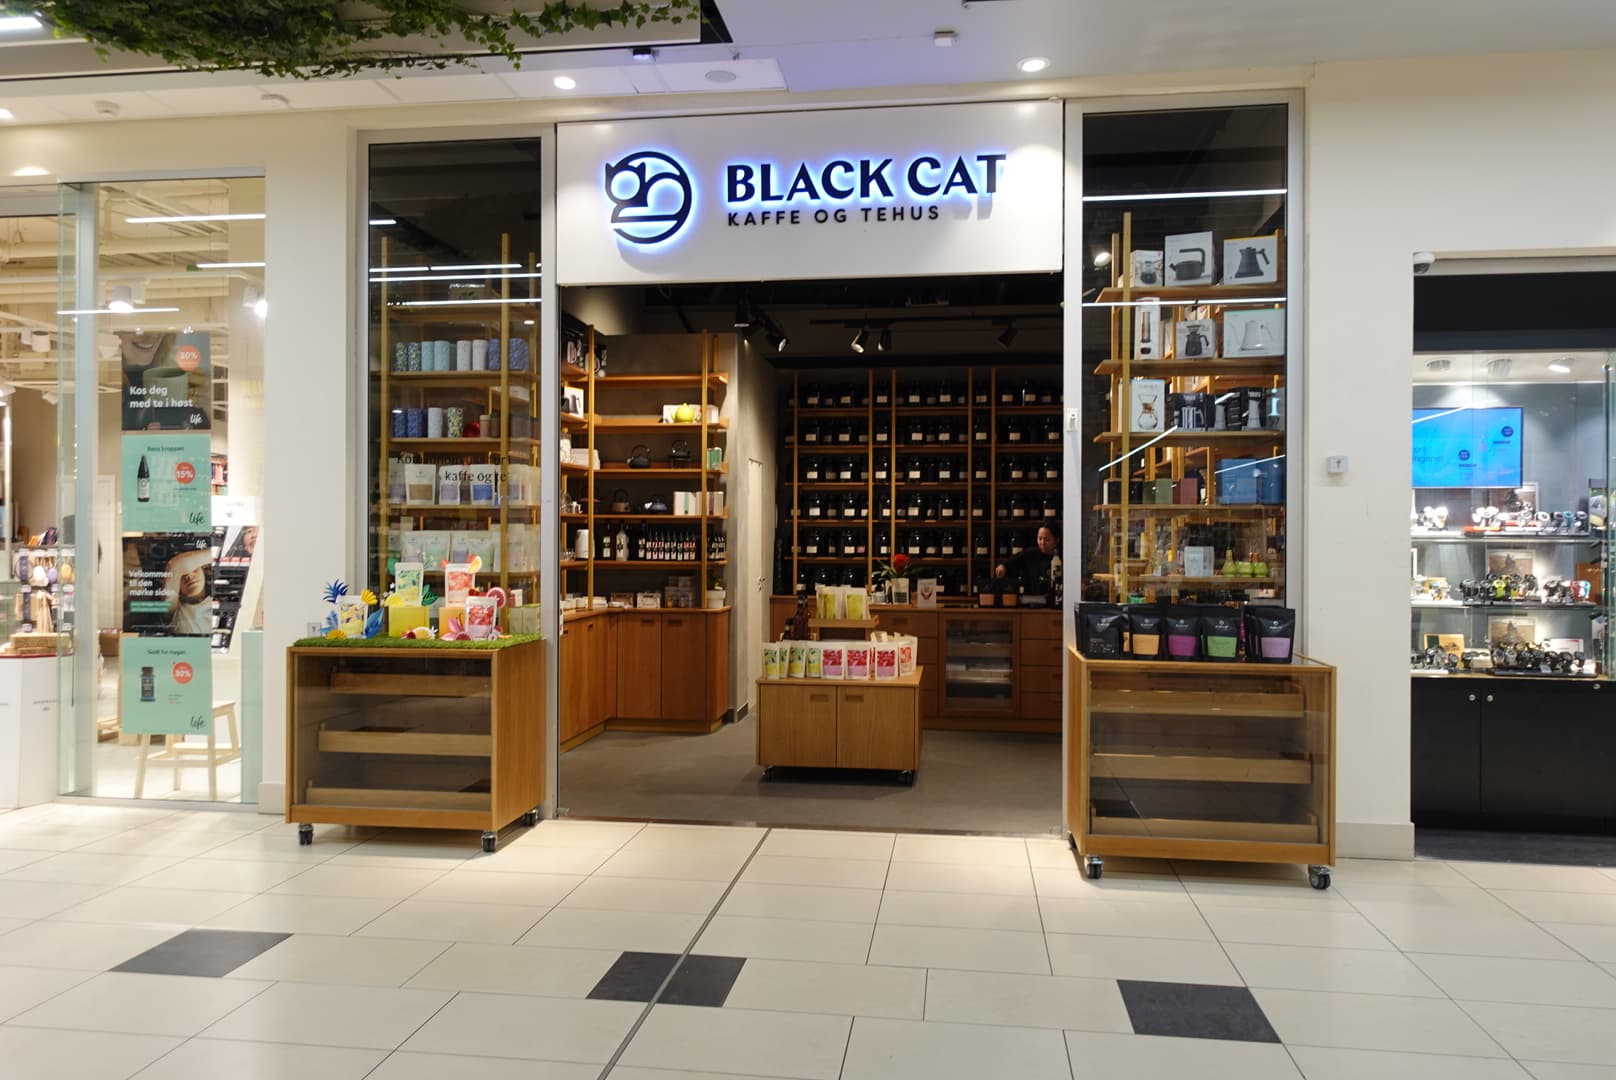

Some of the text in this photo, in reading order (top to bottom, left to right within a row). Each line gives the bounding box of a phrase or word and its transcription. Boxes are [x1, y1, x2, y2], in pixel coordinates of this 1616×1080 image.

[727, 154, 1007, 203] BLACK CAT
[728, 205, 940, 227] KAFFE OG TEHUS
[129, 385, 168, 397] Kos deg
[129, 398, 151, 408] med
[152, 399, 163, 408] te
[171, 398, 193, 408] høst
[176, 470, 194, 479] 15%
[445, 470, 507, 484] kaffe og te
[128, 569, 174, 578] Velkommen
[129, 579, 153, 587] til den
[154, 588, 176, 596] siden
